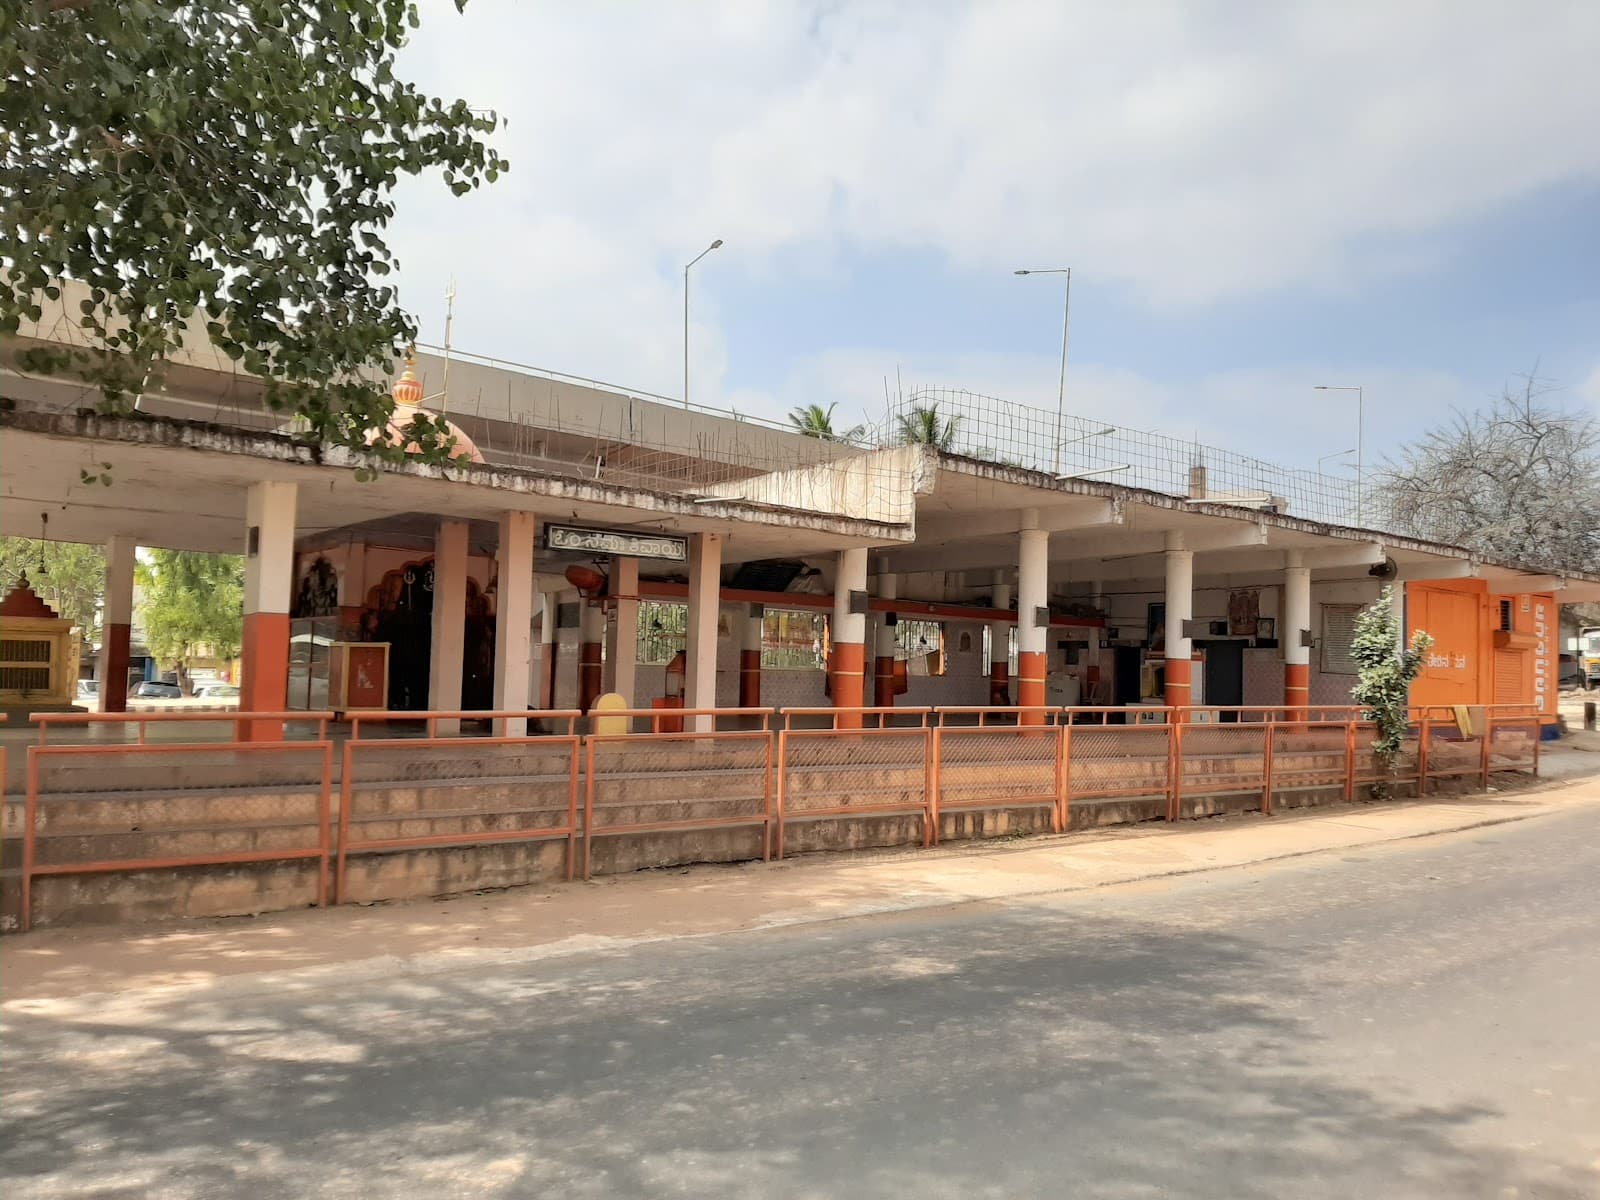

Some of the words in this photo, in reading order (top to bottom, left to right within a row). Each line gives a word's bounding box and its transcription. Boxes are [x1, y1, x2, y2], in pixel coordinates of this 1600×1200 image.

[553, 529, 582, 547] ಓಂ
[584, 533, 625, 551] ನಮಃ
[629, 537, 685, 557] ಶಿವಾಯ
